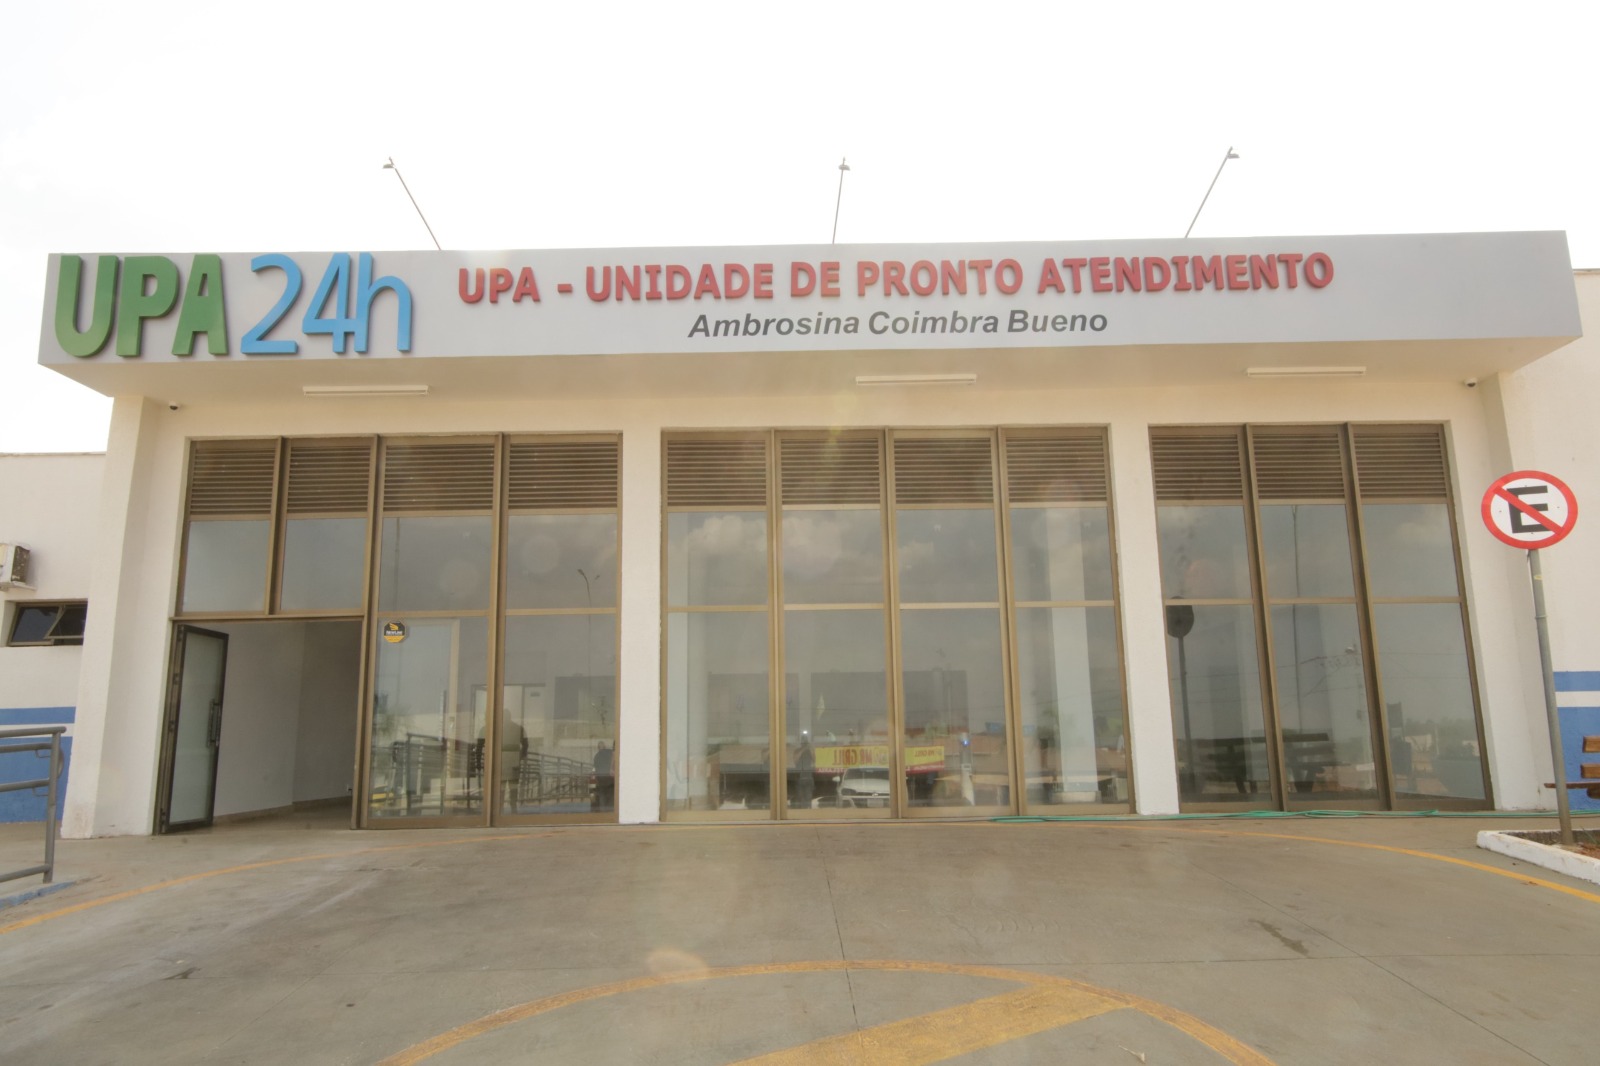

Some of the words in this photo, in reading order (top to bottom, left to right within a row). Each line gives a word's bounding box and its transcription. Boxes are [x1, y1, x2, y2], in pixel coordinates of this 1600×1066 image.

[458, 267, 541, 303] UPA
[557, 283, 573, 293] -
[585, 262, 774, 301] UNIDADE
[790, 261, 841, 298] DE
[856, 257, 1024, 297] PRONTO
[1037, 252, 1334, 294] ATENDIMENTO
[54, 254, 229, 358] UPA
[240, 252, 412, 354] 24h
[687, 311, 860, 338] Ambrosina
[868, 310, 999, 336] Coimbra
[1007, 308, 1108, 334] Bueno
[1506, 485, 1552, 534] E
